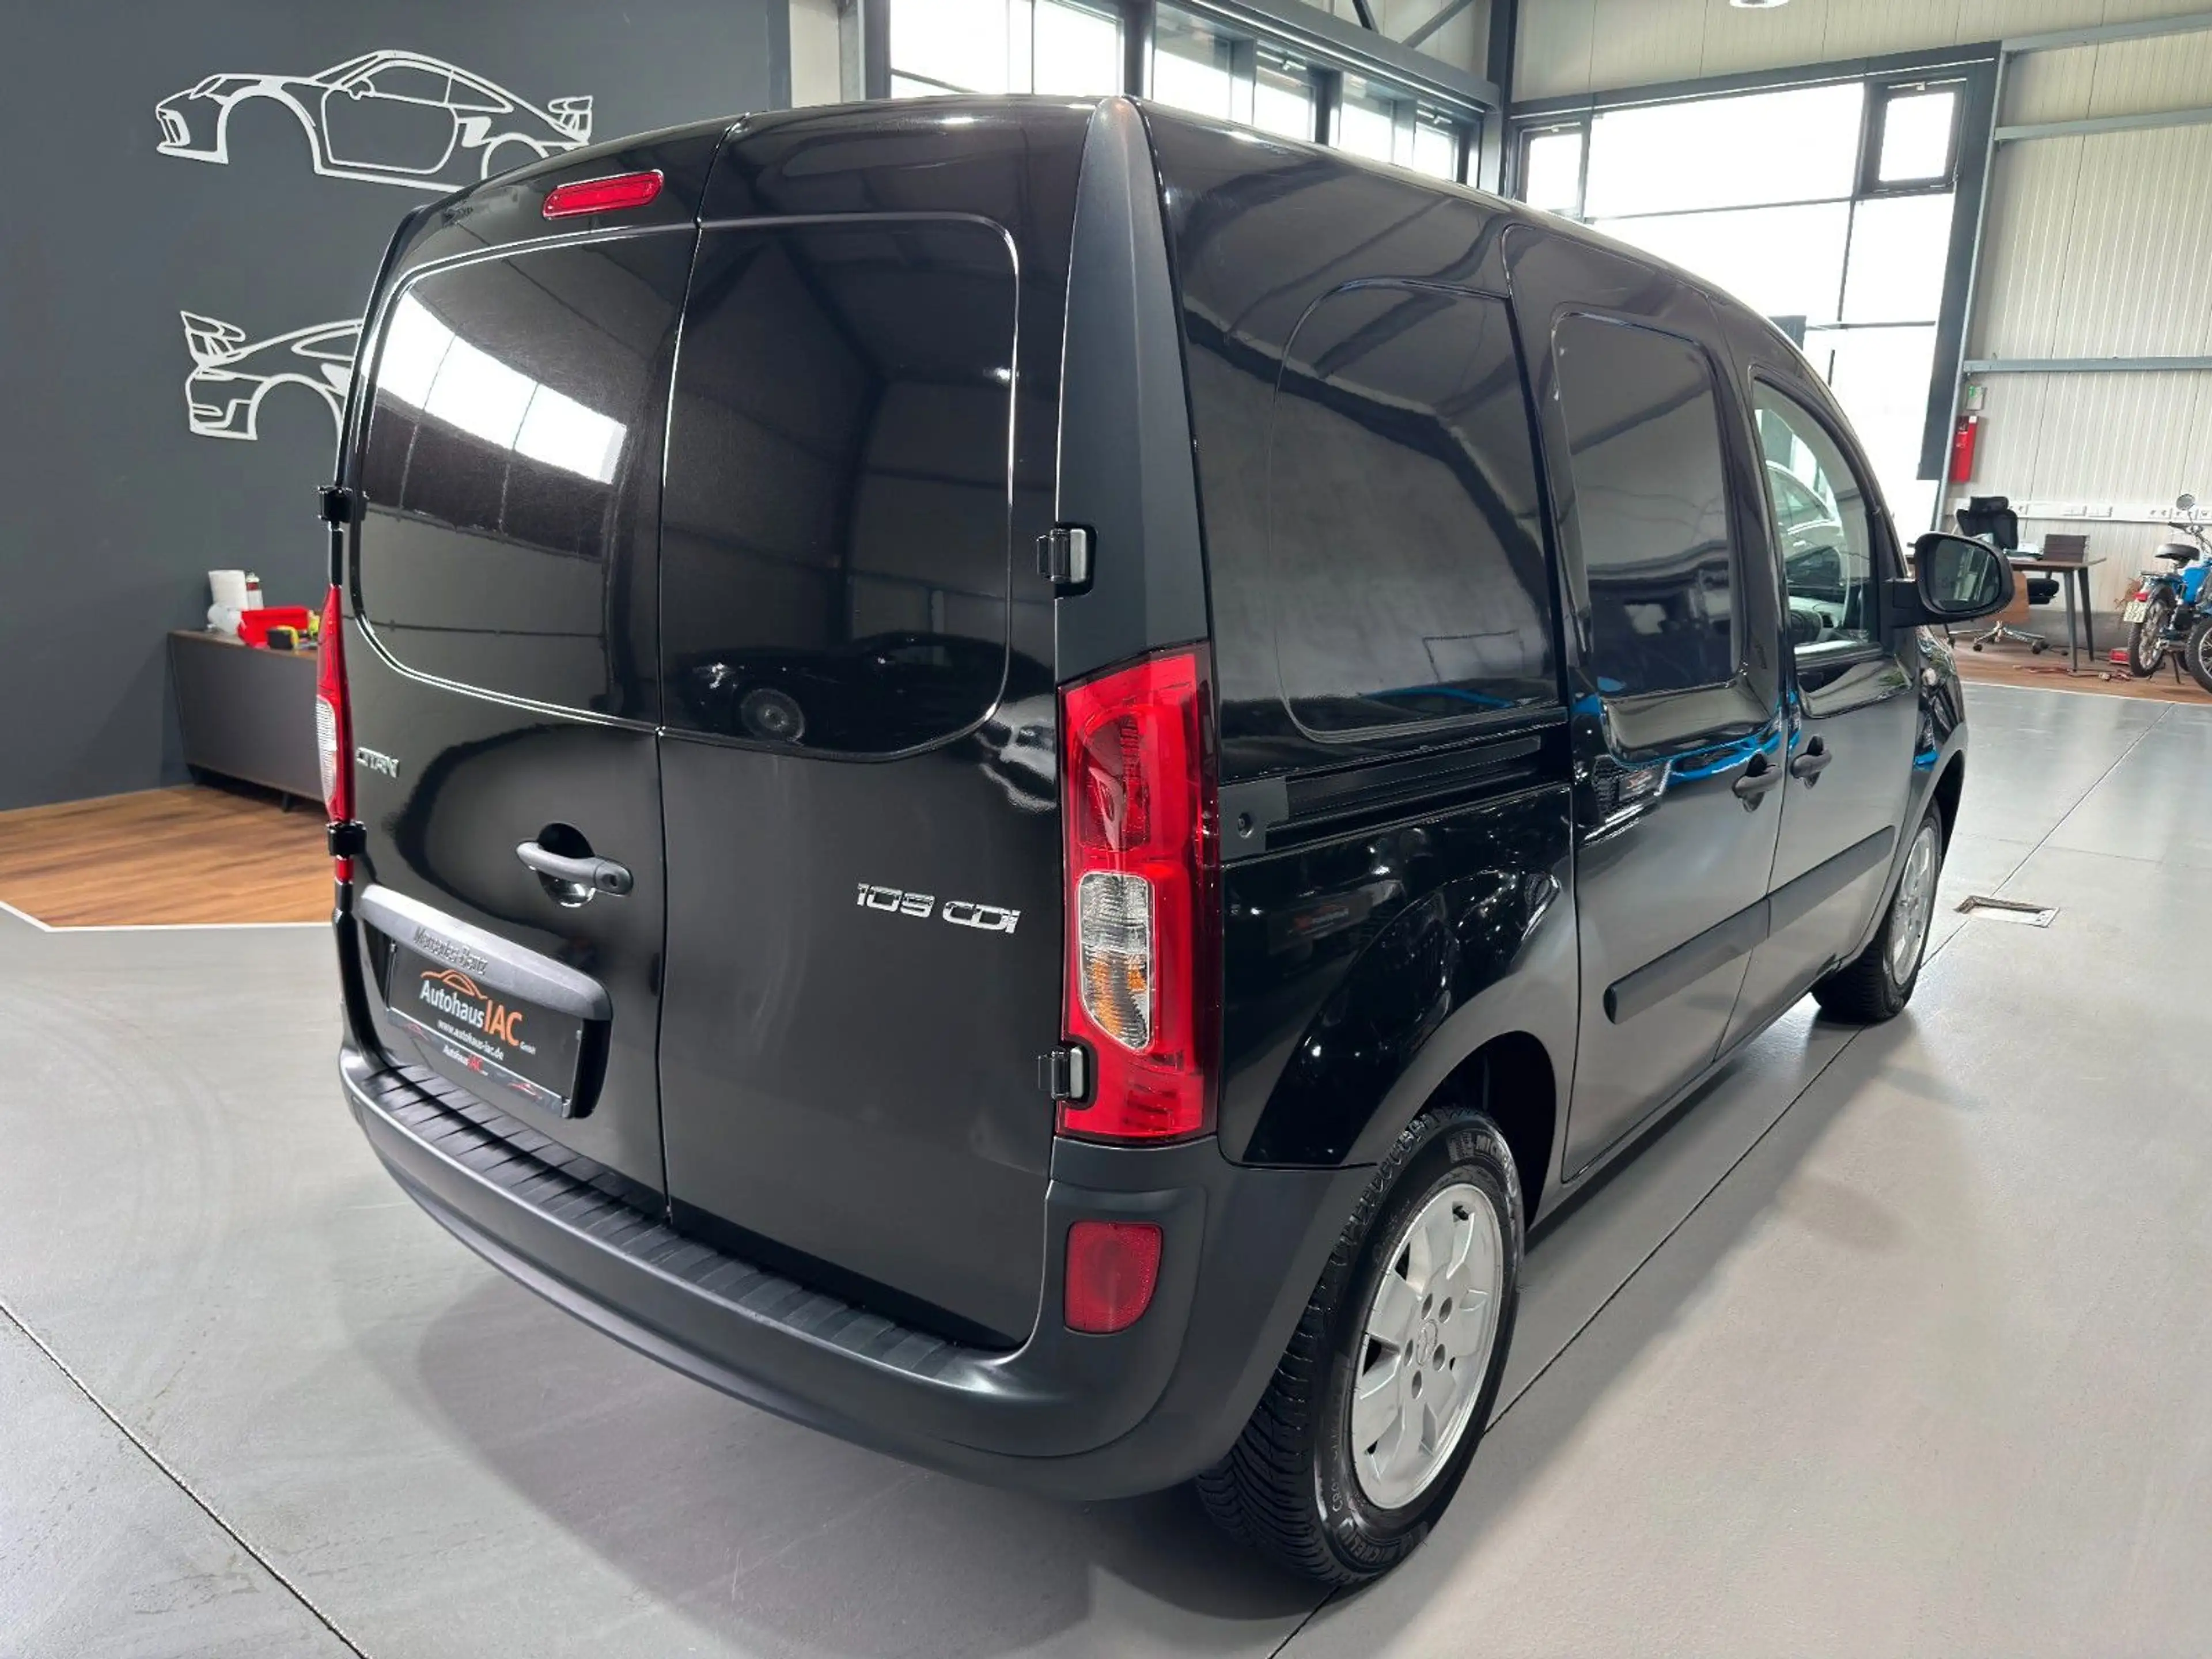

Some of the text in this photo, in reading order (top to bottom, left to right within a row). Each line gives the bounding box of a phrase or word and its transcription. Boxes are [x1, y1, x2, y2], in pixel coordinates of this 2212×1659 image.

[413, 926, 488, 975] Mercedes-Benz
[420, 980, 485, 1028] Autohaus
[483, 999, 522, 1046] IAC
